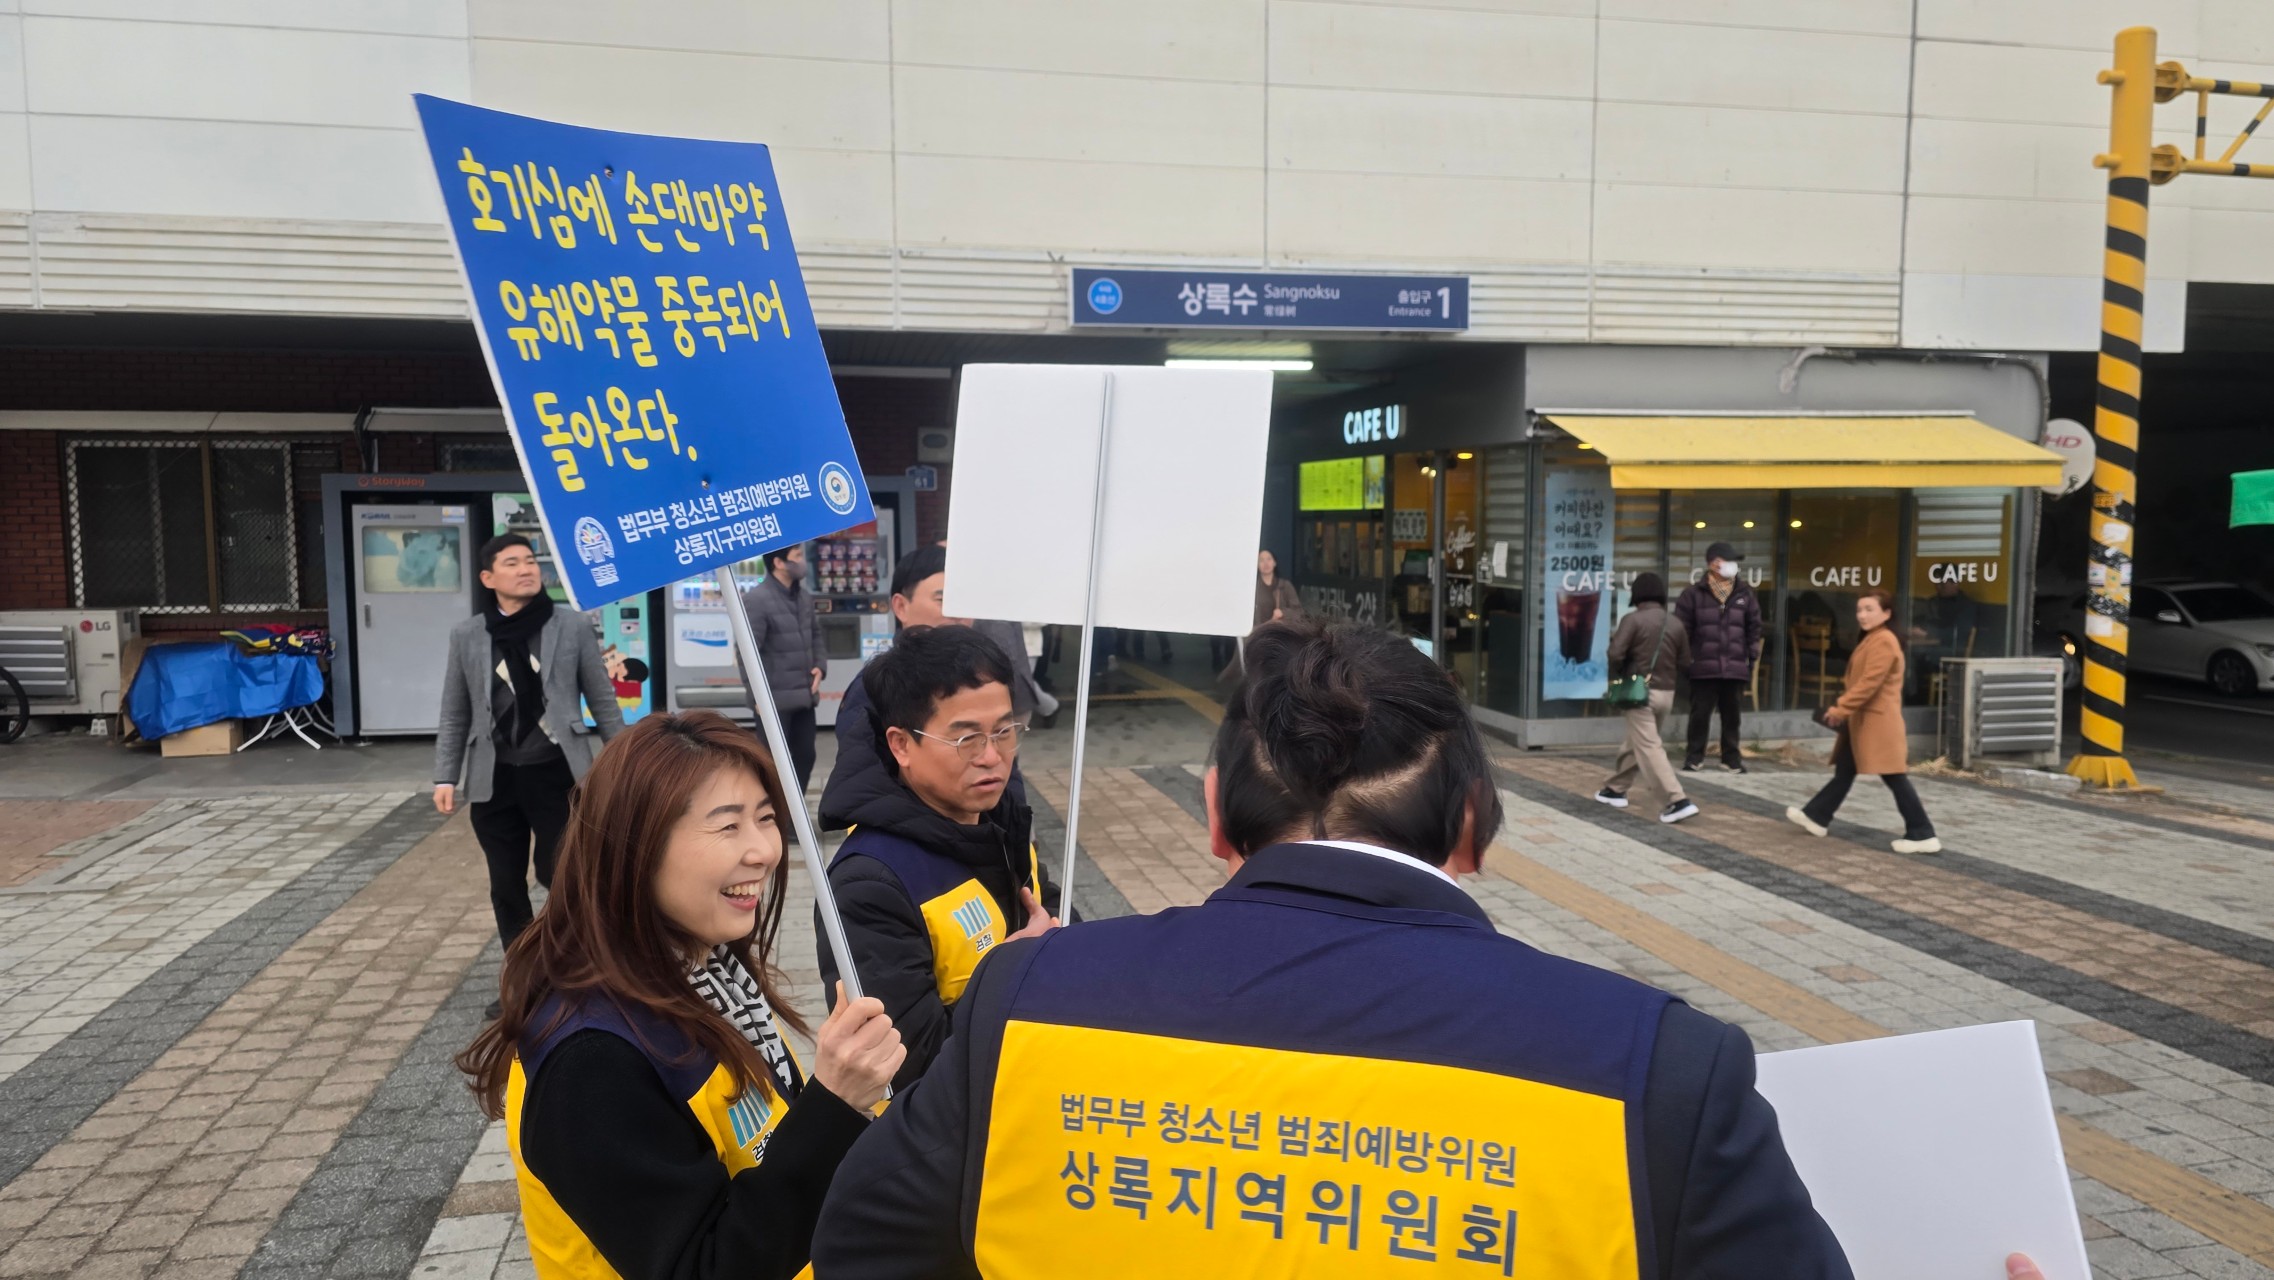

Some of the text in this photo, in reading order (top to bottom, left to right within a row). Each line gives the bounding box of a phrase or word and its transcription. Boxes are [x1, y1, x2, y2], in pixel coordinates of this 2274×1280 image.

[457, 147, 618, 250] 호기심에
[1177, 282, 1259, 317] 상록수
[1263, 283, 1341, 302] Sangnoksu
[1398, 289, 1432, 304] 출입구
[1437, 286, 1450, 320] 1
[499, 275, 791, 368] 유해약물 중독되어
[1388, 304, 1432, 317] Entrance
[1343, 404, 1400, 445] CAFE U
[532, 385, 698, 493] 돌아온다.
[617, 473, 812, 544] 법무부 청소년 범죄예방위원
[673, 513, 783, 566] 상록지구위원회
[1551, 554, 1605, 572] 2500원
[1810, 566, 1882, 587] CAFE U
[1928, 561, 1998, 584] CAFE U
[1562, 571, 1616, 592] CAFE
[1748, 567, 1763, 588] U
[95, 621, 111, 632] LG
[975, 933, 994, 952] 검찰
[1060, 1092, 1518, 1189] 법무부 청소년 범죄예방위원
[1059, 1149, 1519, 1278] 상록지역위원회
